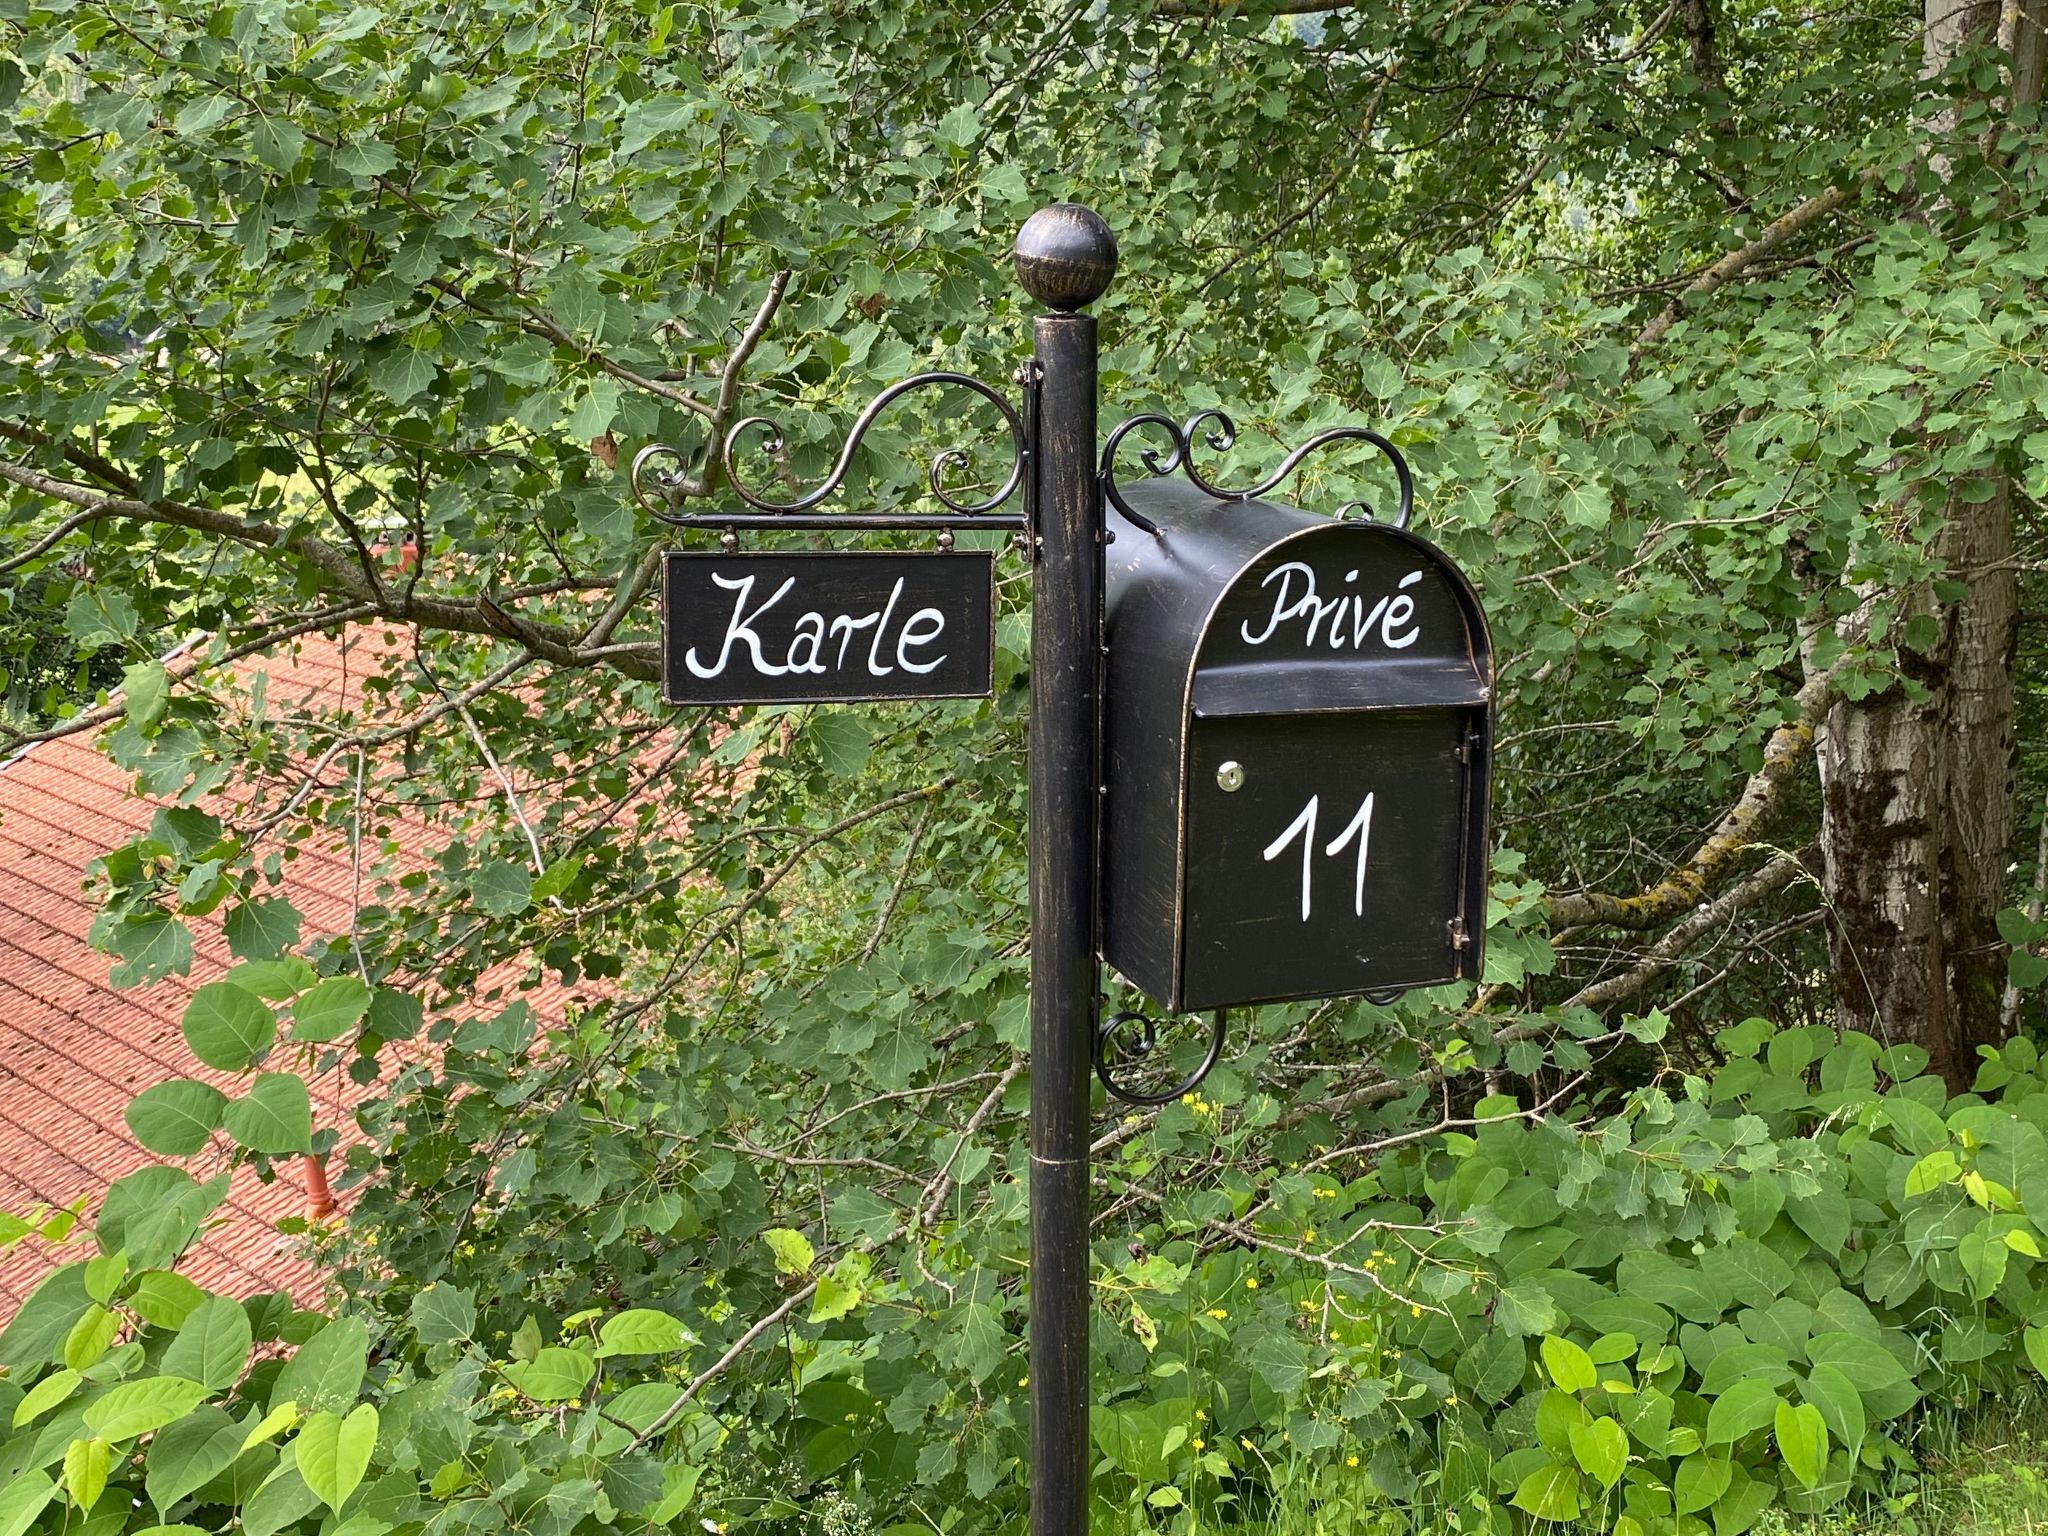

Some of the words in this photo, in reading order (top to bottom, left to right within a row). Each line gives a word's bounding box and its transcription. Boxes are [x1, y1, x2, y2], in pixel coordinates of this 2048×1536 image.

[685, 572, 948, 679] Karle
[1240, 561, 1423, 650] Privé
[1263, 791, 1374, 922] 11
